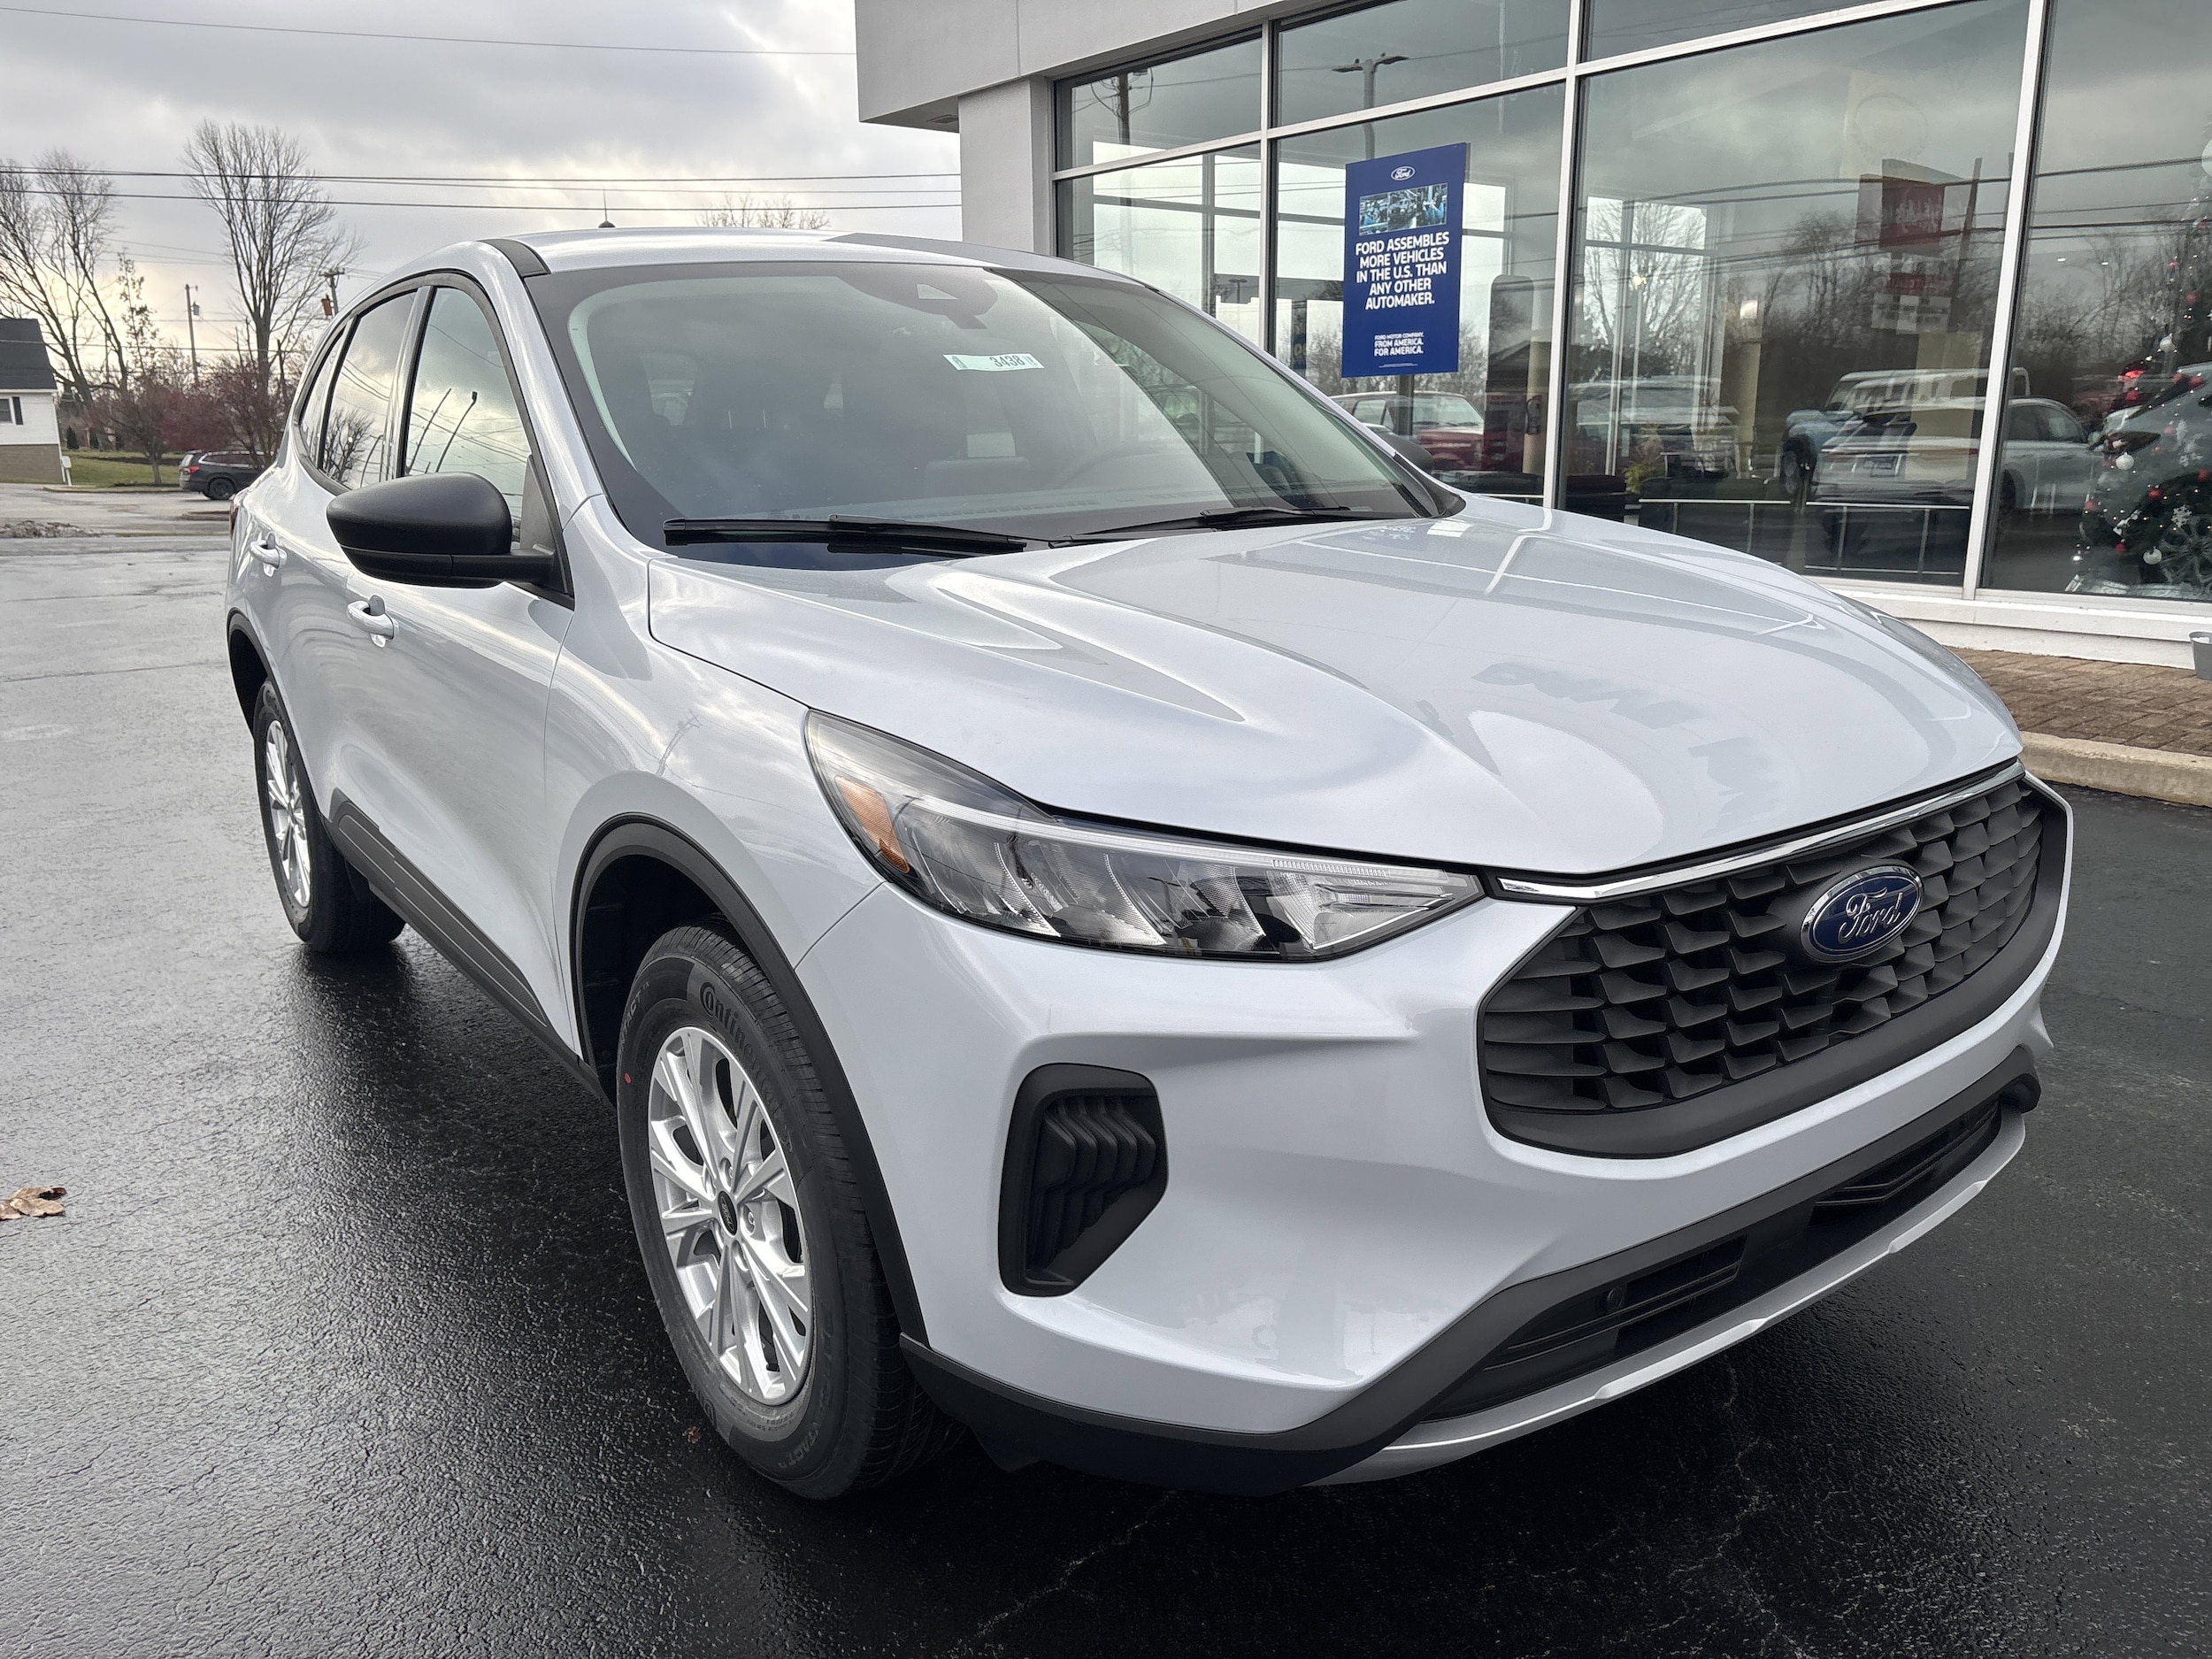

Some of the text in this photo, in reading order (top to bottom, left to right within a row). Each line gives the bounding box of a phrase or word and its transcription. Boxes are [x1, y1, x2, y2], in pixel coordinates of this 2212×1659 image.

[1394, 168, 1411, 179] Ford
[1356, 231, 1449, 256] FORD ASSEMBLES
[1360, 247, 1444, 269] MORE VEHICLES
[1356, 261, 1447, 283] IN THE U.S. THAN
[1369, 277, 1432, 296] ANY OTHER
[1365, 292, 1435, 310] AUTOMAKER.
[1374, 345, 1424, 357] FOR AMERICA.
[1394, 337, 1424, 347] AMERICA.
[989, 355, 1025, 367] 3438
[1837, 887, 1903, 944] Ford
